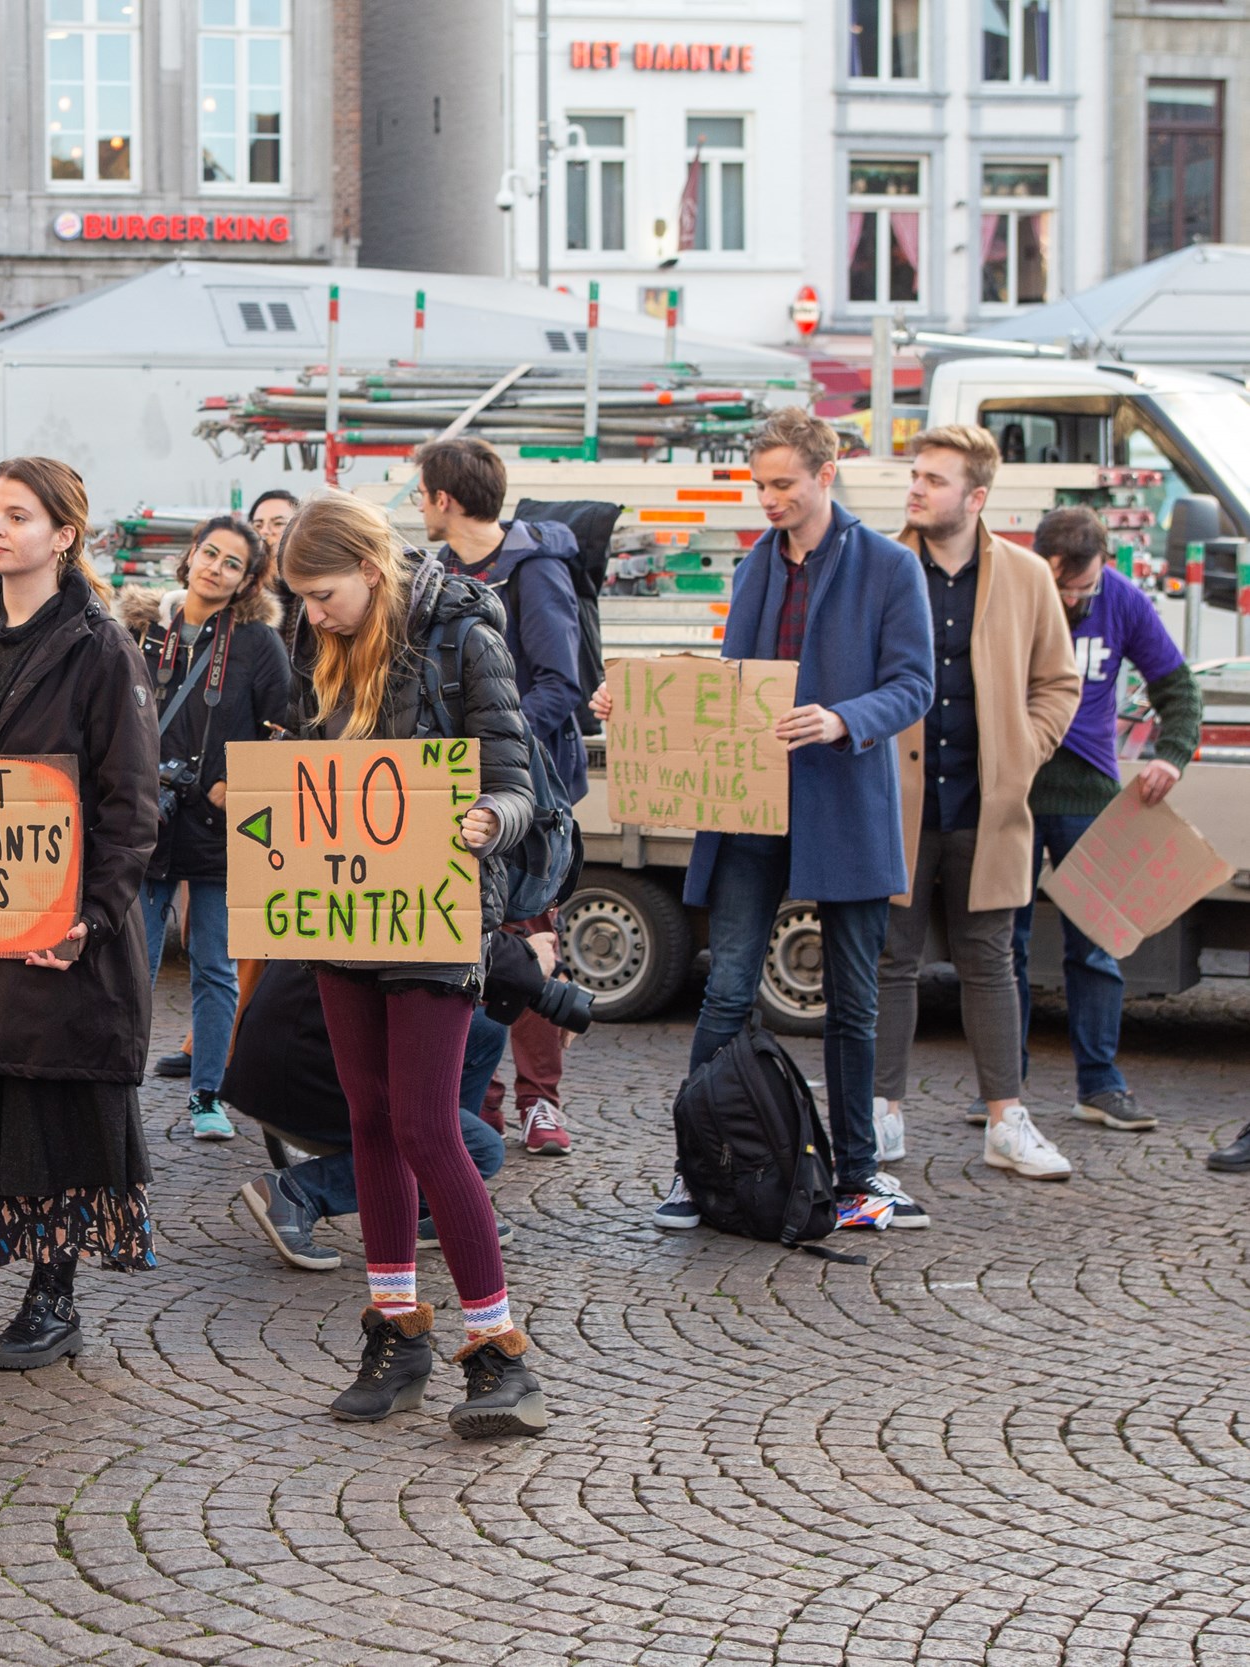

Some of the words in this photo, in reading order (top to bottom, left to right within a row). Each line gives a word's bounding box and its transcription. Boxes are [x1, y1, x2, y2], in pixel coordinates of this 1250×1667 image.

[571, 41, 620, 69] HET
[634, 41, 754, 72] HAANTJE
[83, 213, 206, 241] BURGER
[213, 215, 290, 242] KING
[165, 632, 178, 660] Canon
[210, 665, 221, 686] EOS
[623, 662, 676, 718] IK
[694, 672, 780, 736] EIS
[610, 722, 668, 753] NIET
[693, 736, 766, 772] VEEL
[295, 753, 407, 849] NO
[647, 796, 683, 817] WAT
[695, 800, 724, 826] IK
[740, 799, 783, 831] WIL
[324, 854, 367, 885] TO
